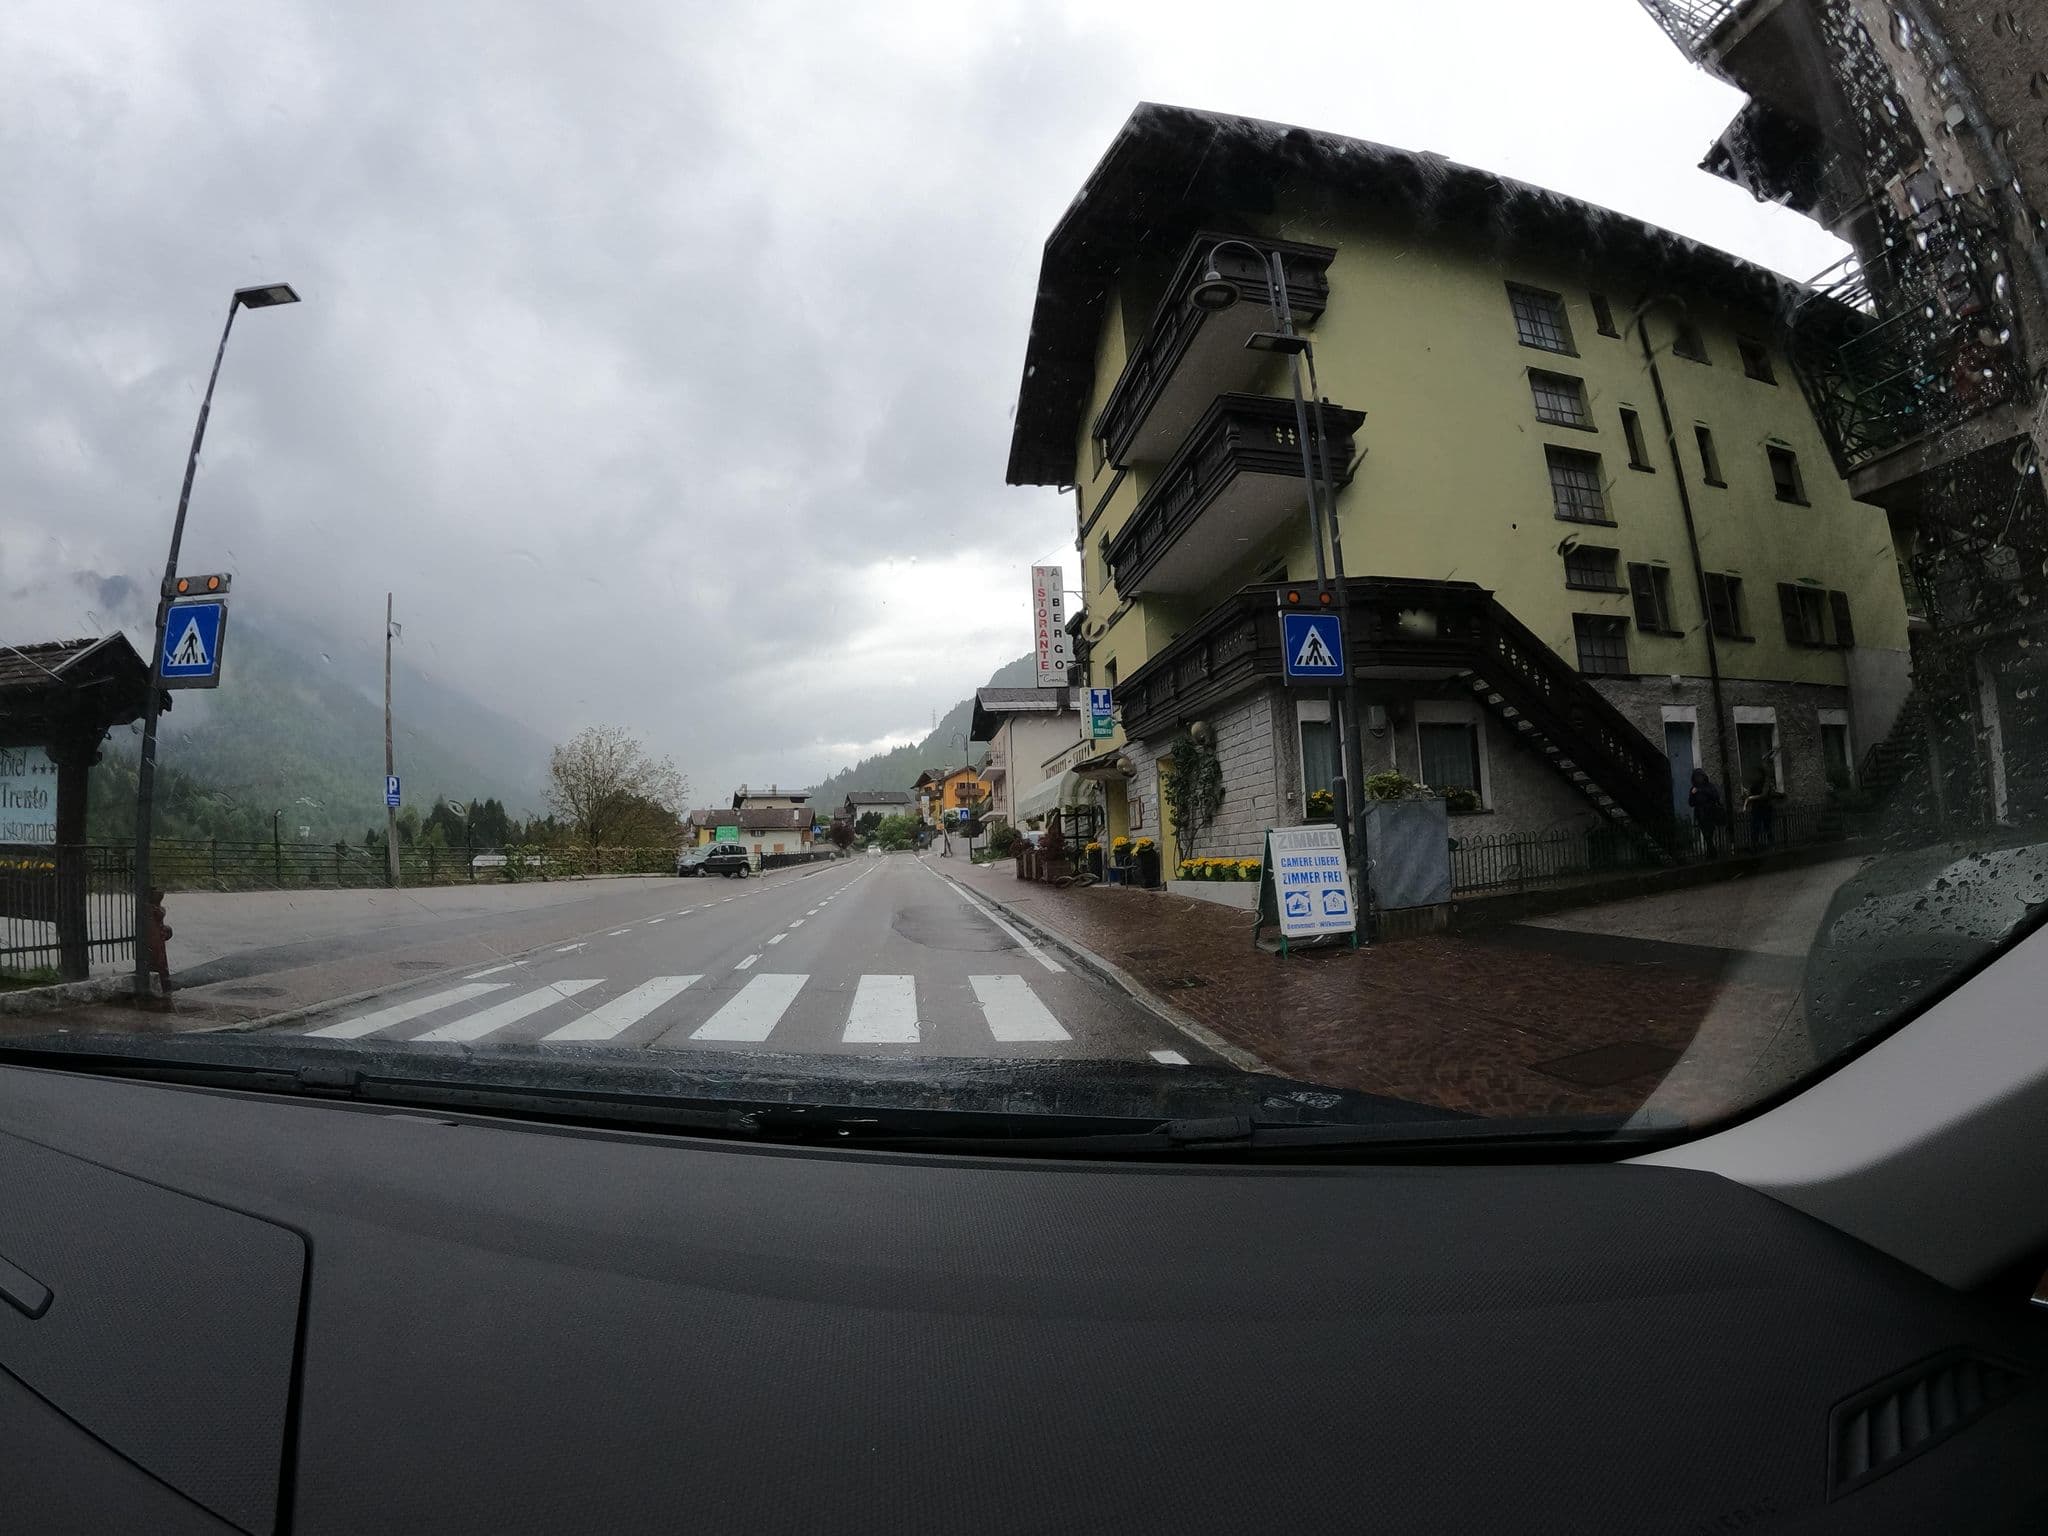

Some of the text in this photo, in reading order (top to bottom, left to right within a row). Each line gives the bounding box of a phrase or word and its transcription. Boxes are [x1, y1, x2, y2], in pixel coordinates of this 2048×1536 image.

[1037, 567, 1049, 670] RISTORANTE
[1051, 567, 1065, 670] ALBERGO
[0, 782, 48, 809] Trento
[389, 777, 398, 794] P
[0, 818, 56, 842] istorante
[1277, 832, 1339, 849] ZIMMER
[1281, 856, 1340, 868] CAMERE LIBERE
[1283, 870, 1342, 885] ZIMMER FREI
